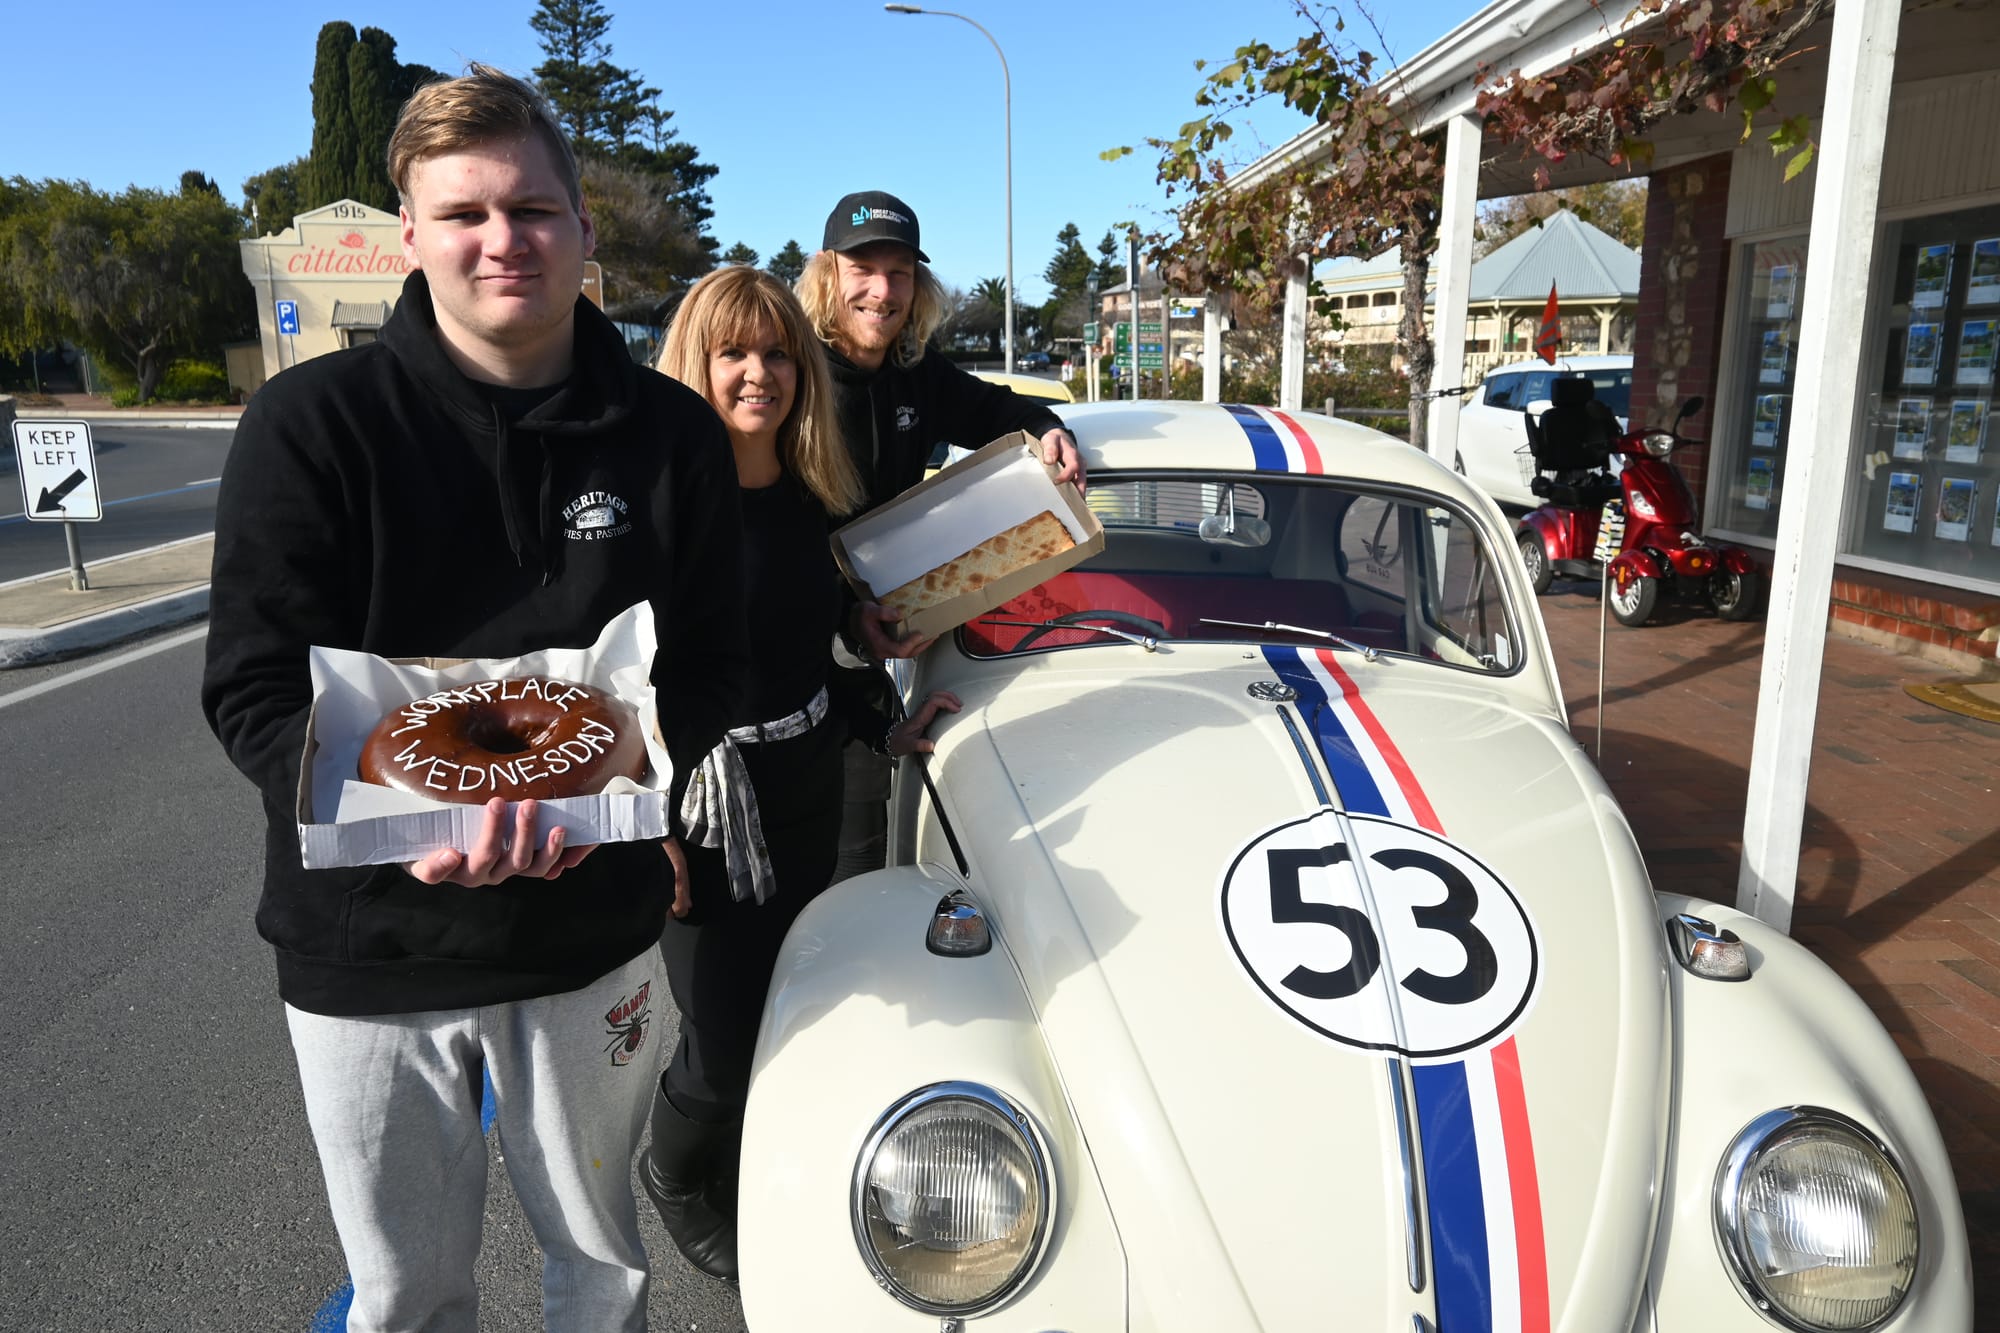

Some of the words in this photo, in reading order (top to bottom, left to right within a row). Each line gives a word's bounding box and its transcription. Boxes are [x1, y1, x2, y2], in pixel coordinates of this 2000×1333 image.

[332, 206, 366, 219] 1915
[280, 304, 291, 318] P
[28, 430, 76, 445] KEEP
[33, 450, 76, 465] LEFT
[562, 491, 628, 521] HERITAGE
[564, 528, 582, 540] PIES
[585, 531, 593, 540] &
[596, 521, 632, 539] PASTRIES
[391, 677, 590, 738] WORKPLACE
[393, 717, 616, 792] WEDNESDAY
[1266, 842, 1499, 1005] 53
